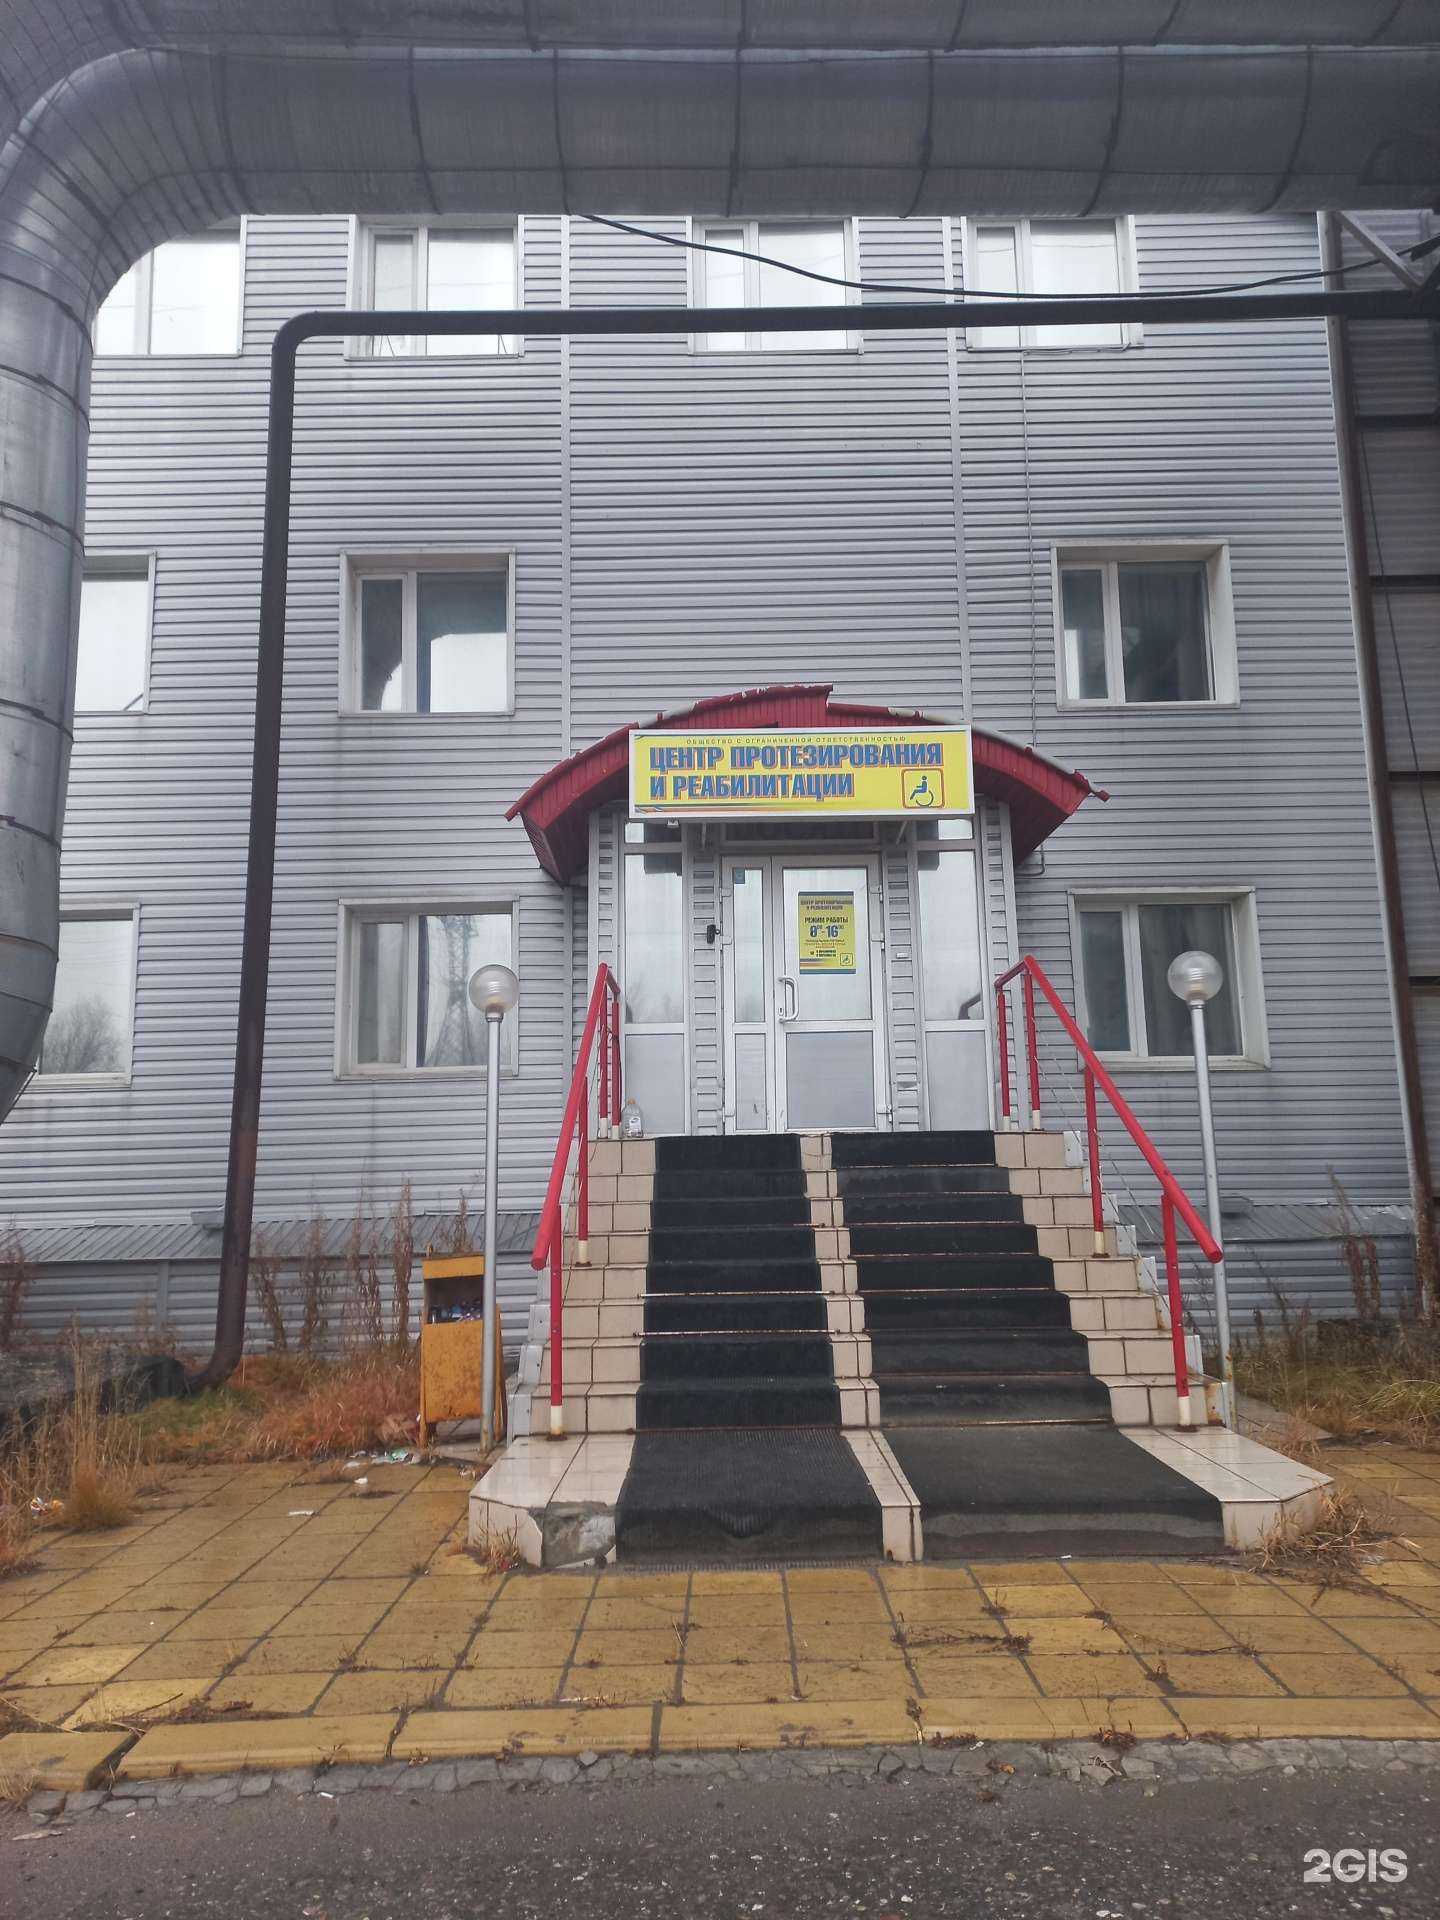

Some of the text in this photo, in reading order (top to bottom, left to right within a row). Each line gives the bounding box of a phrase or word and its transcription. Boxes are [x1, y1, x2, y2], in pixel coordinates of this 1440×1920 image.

[649, 743, 944, 773] ЦЕНТР ПРОТЕЗИРОВАНИЯ
[649, 773, 855, 801] И РЕАБИЛИТАЦИИ
[804, 916, 825, 924] РЕЖИМ
